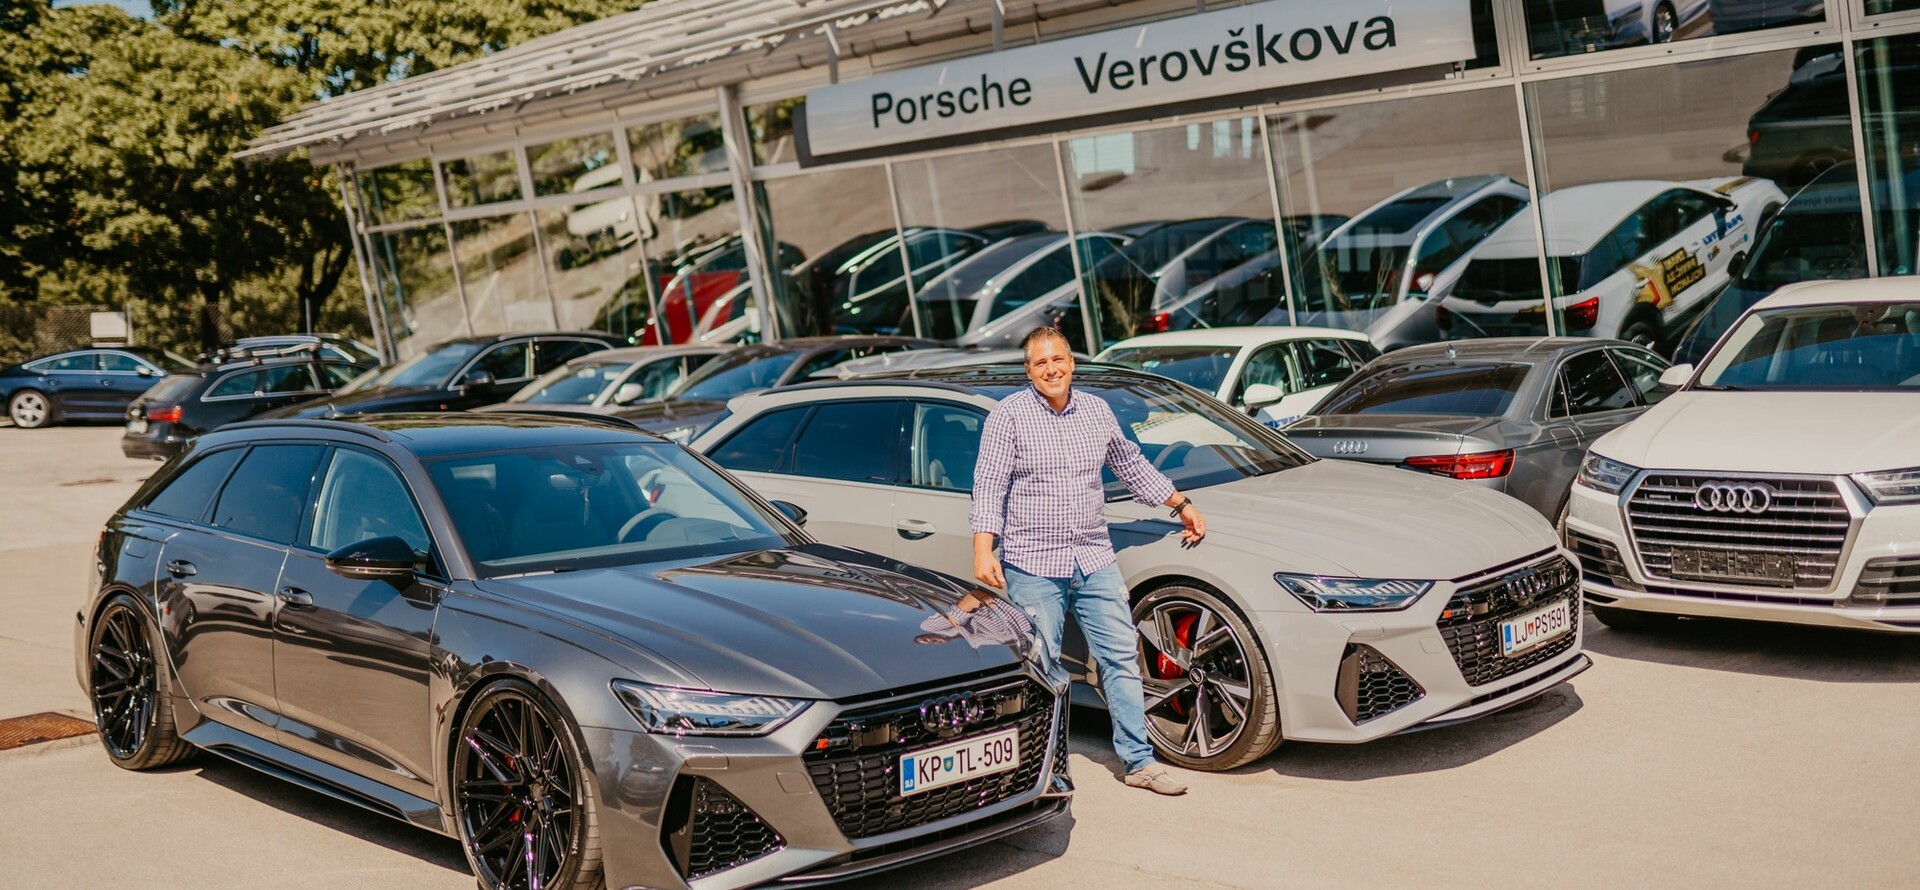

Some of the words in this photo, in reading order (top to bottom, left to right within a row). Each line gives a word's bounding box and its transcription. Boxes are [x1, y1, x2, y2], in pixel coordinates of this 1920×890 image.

[871, 73, 1032, 129] Porsche
[1074, 15, 1398, 95] Verovškova
[1514, 621, 1528, 645] LJ
[1534, 605, 1567, 637] PS1591
[919, 755, 942, 785] KP
[956, 737, 1013, 774] TL-509
